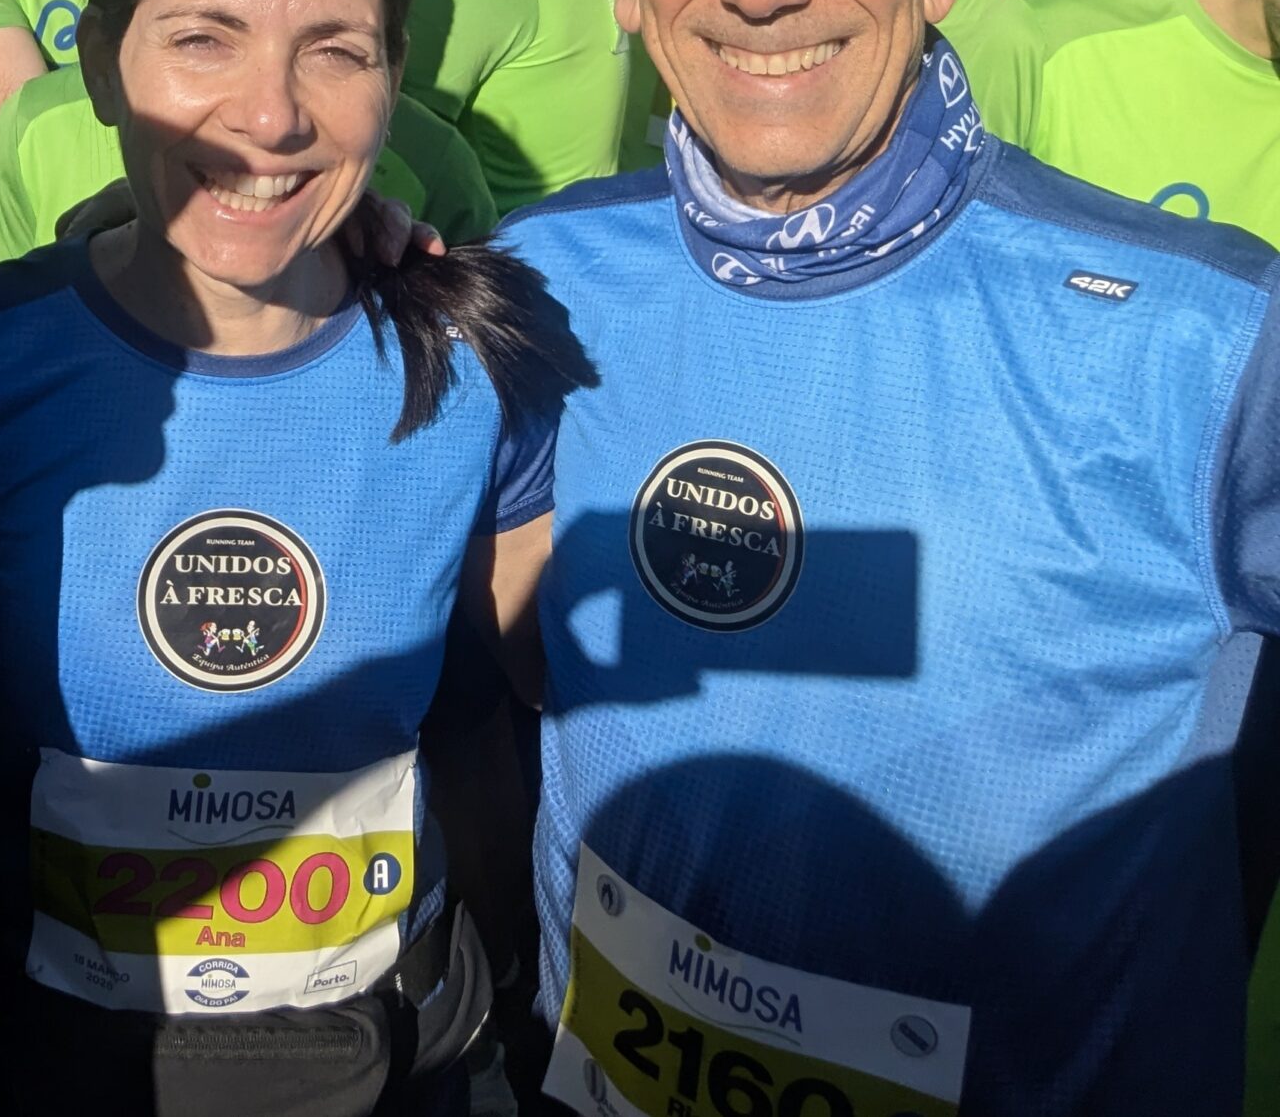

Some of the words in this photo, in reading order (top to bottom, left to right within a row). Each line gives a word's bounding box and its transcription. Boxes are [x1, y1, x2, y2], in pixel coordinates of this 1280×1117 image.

[1070, 276, 1132, 298] 42K
[697, 467, 726, 480] RUNNING
[727, 474, 744, 483] TEAM
[666, 477, 775, 520] UNIDOS
[649, 501, 666, 528] À
[672, 512, 781, 558] FRESCA
[206, 538, 236, 546] RUNNING
[174, 554, 292, 575] UNIDOS
[160, 579, 181, 605] À
[187, 586, 304, 607] FRESCA
[168, 789, 296, 825] MIMOSA
[93, 851, 351, 925] 2200
[373, 859, 389, 888] A
[196, 925, 246, 948] Ana
[199, 960, 239, 974] CORRIDA
[201, 978, 236, 989] MIMOSA
[669, 939, 803, 1034] MIMOSA
[194, 995, 209, 1004] DIA
[223, 995, 238, 1005] PAI
